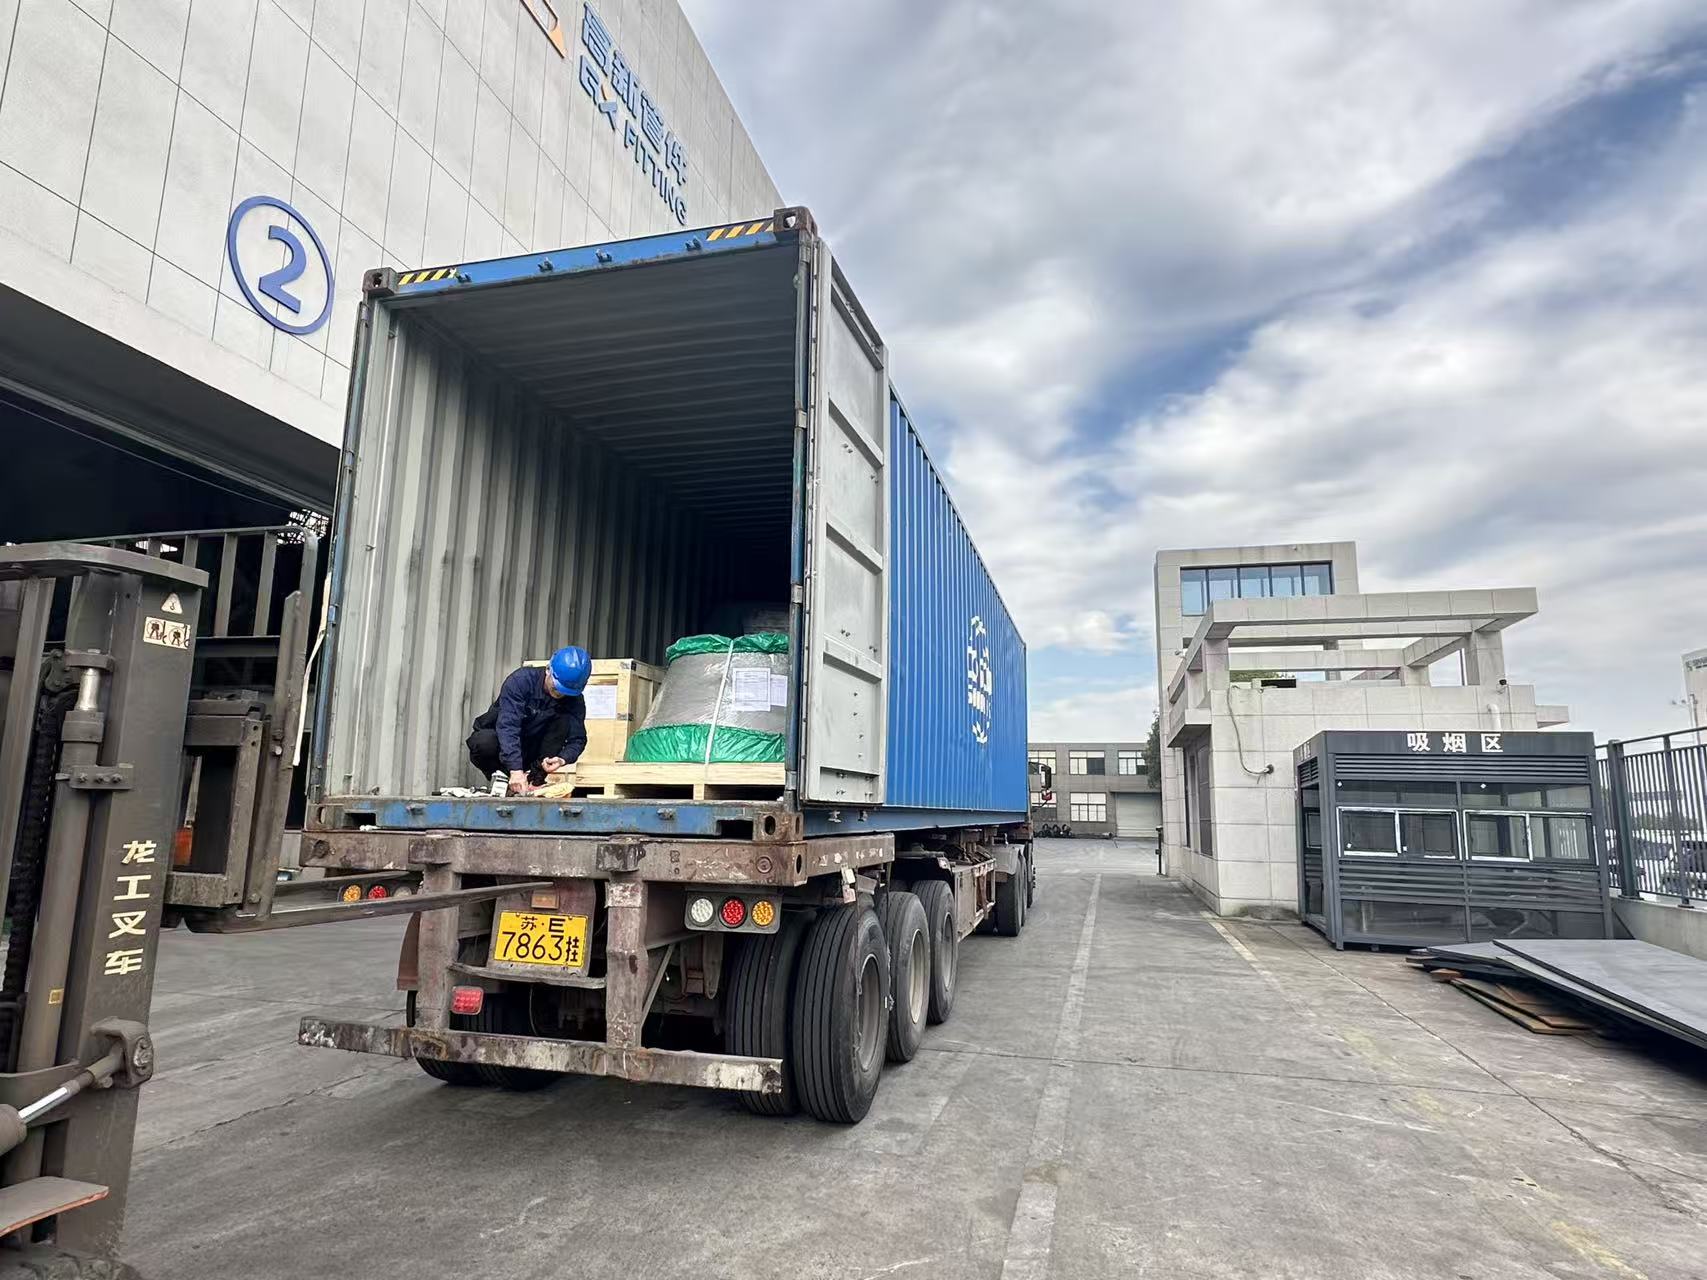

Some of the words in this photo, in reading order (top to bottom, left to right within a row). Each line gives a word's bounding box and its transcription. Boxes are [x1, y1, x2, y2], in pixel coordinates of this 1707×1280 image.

[623, 119, 687, 226] FITTING
[1406, 732, 1504, 753] 吸烟区
[103, 839, 158, 976] 龙工叉车
[501, 930, 580, 963] 7863挂
